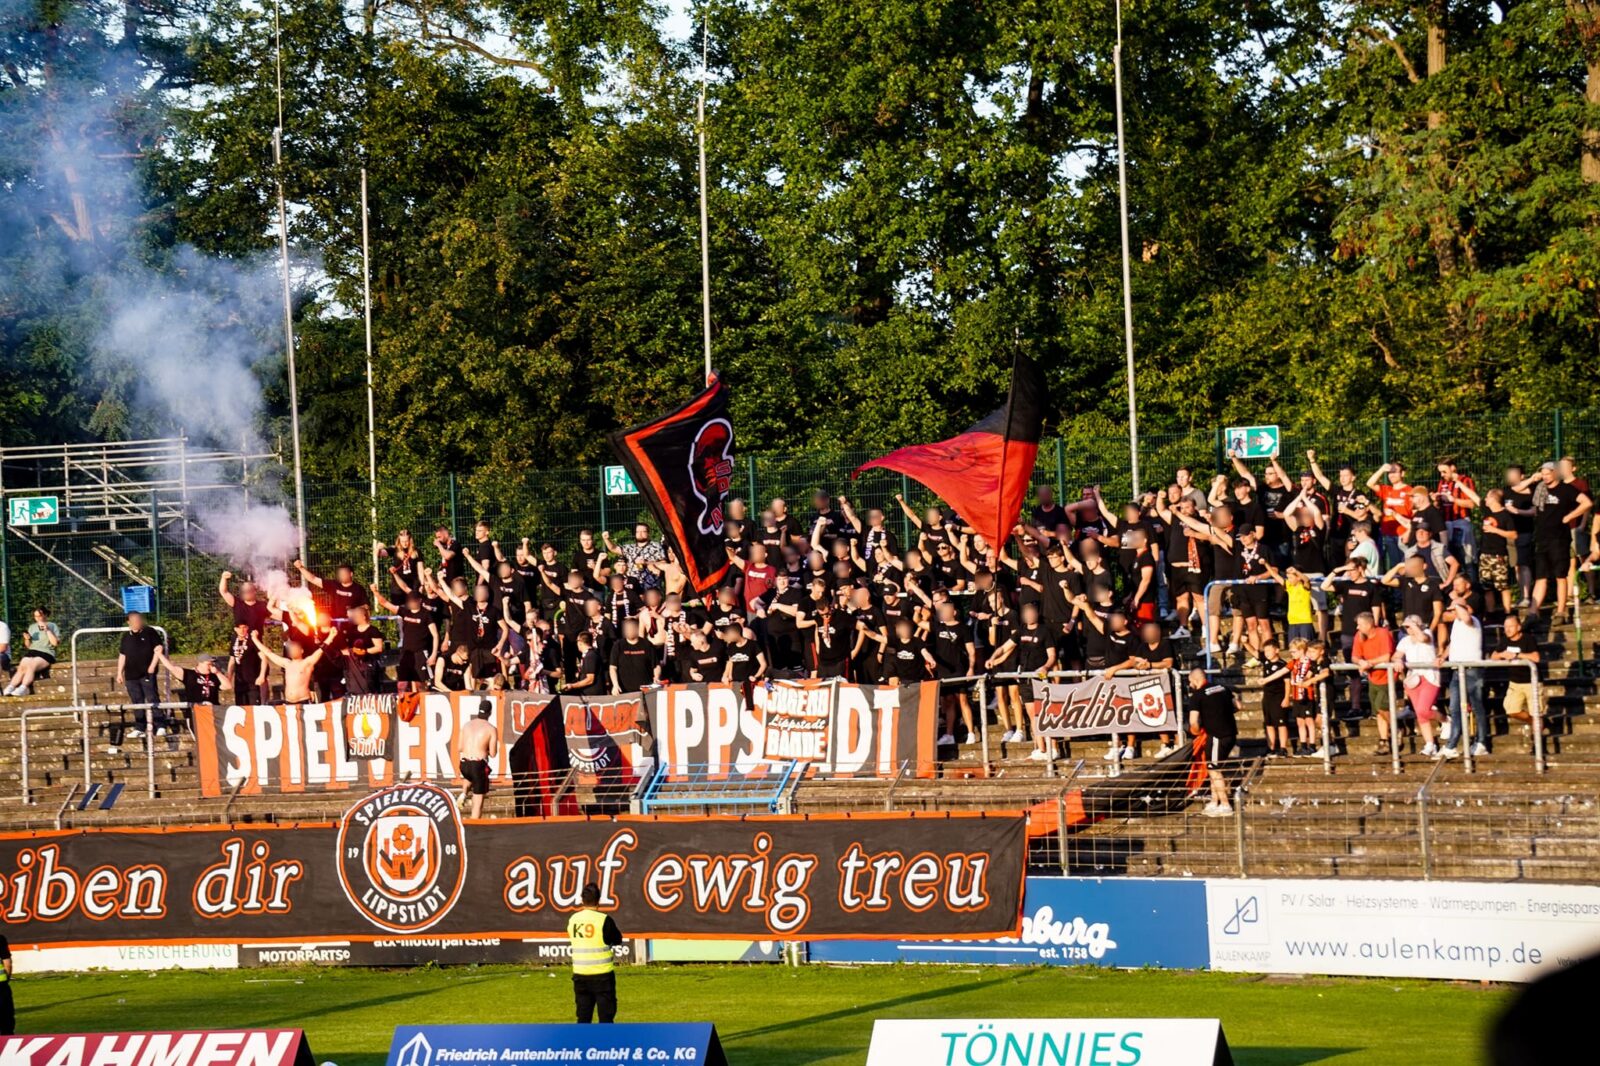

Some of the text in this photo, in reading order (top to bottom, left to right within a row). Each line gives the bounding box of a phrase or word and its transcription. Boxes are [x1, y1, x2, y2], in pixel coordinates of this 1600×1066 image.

[347, 693, 393, 714] BANANA
[767, 687, 829, 718] JUGEND
[1038, 682, 1135, 732] Walibo
[768, 714, 827, 732] Lippstadt
[349, 737, 386, 757] SQUAD
[766, 731, 827, 759] BANDE
[355, 788, 450, 826] SPIELVEREIN
[348, 844, 457, 859] 19 08
[0, 831, 988, 931] iben dir auf ewig treu
[362, 885, 447, 923] LIPPSTADT
[1281, 893, 1297, 906] PV
[1308, 893, 1336, 908] Solar
[1346, 895, 1419, 910] Heizsysteme
[1527, 898, 1600, 918] Energiespars
[573, 923, 595, 939] K9
[118, 944, 232, 961] VERSICHERUNG
[1039, 947, 1089, 959] est. 1758
[1215, 950, 1272, 962] AULENKAMP
[1285, 936, 1542, 967] www.aulenkamp.de
[436, 1047, 697, 1061] Friedrich Amtenbrink GmbH & Co. KG
[940, 1023, 1144, 1066] TÖNNIES
